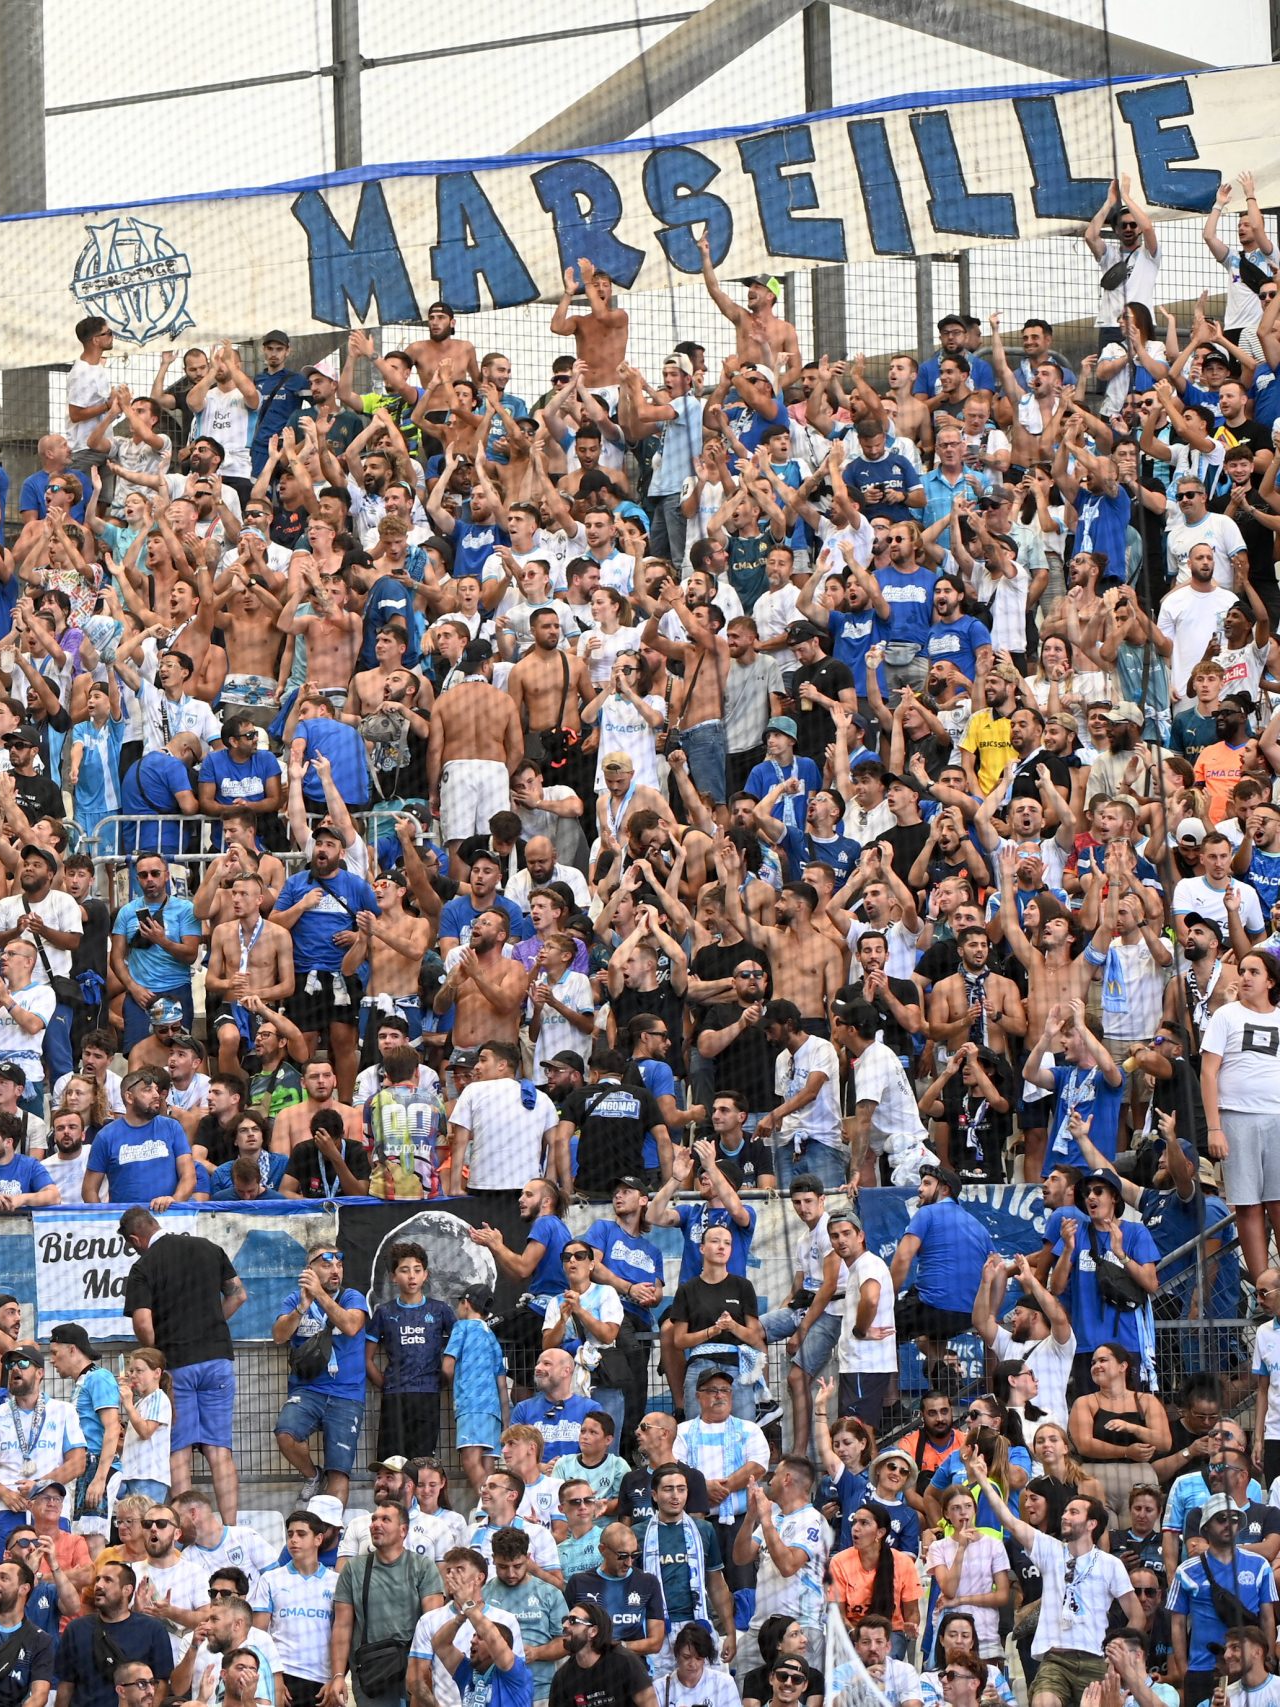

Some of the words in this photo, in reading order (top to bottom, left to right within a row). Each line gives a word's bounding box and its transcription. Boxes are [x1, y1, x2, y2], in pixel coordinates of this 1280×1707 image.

[290, 80, 1222, 329] MARSEILLE
[1248, 871, 1280, 887] CMAC
[39, 1231, 191, 1263] Bienve
[83, 1268, 128, 1299] Ma
[400, 1326, 426, 1336] Uber
[400, 1335, 426, 1346] Eats
[632, 1507, 655, 1518] CMA
[514, 1611, 542, 1619] ndstad
[612, 1613, 642, 1624] CGM
